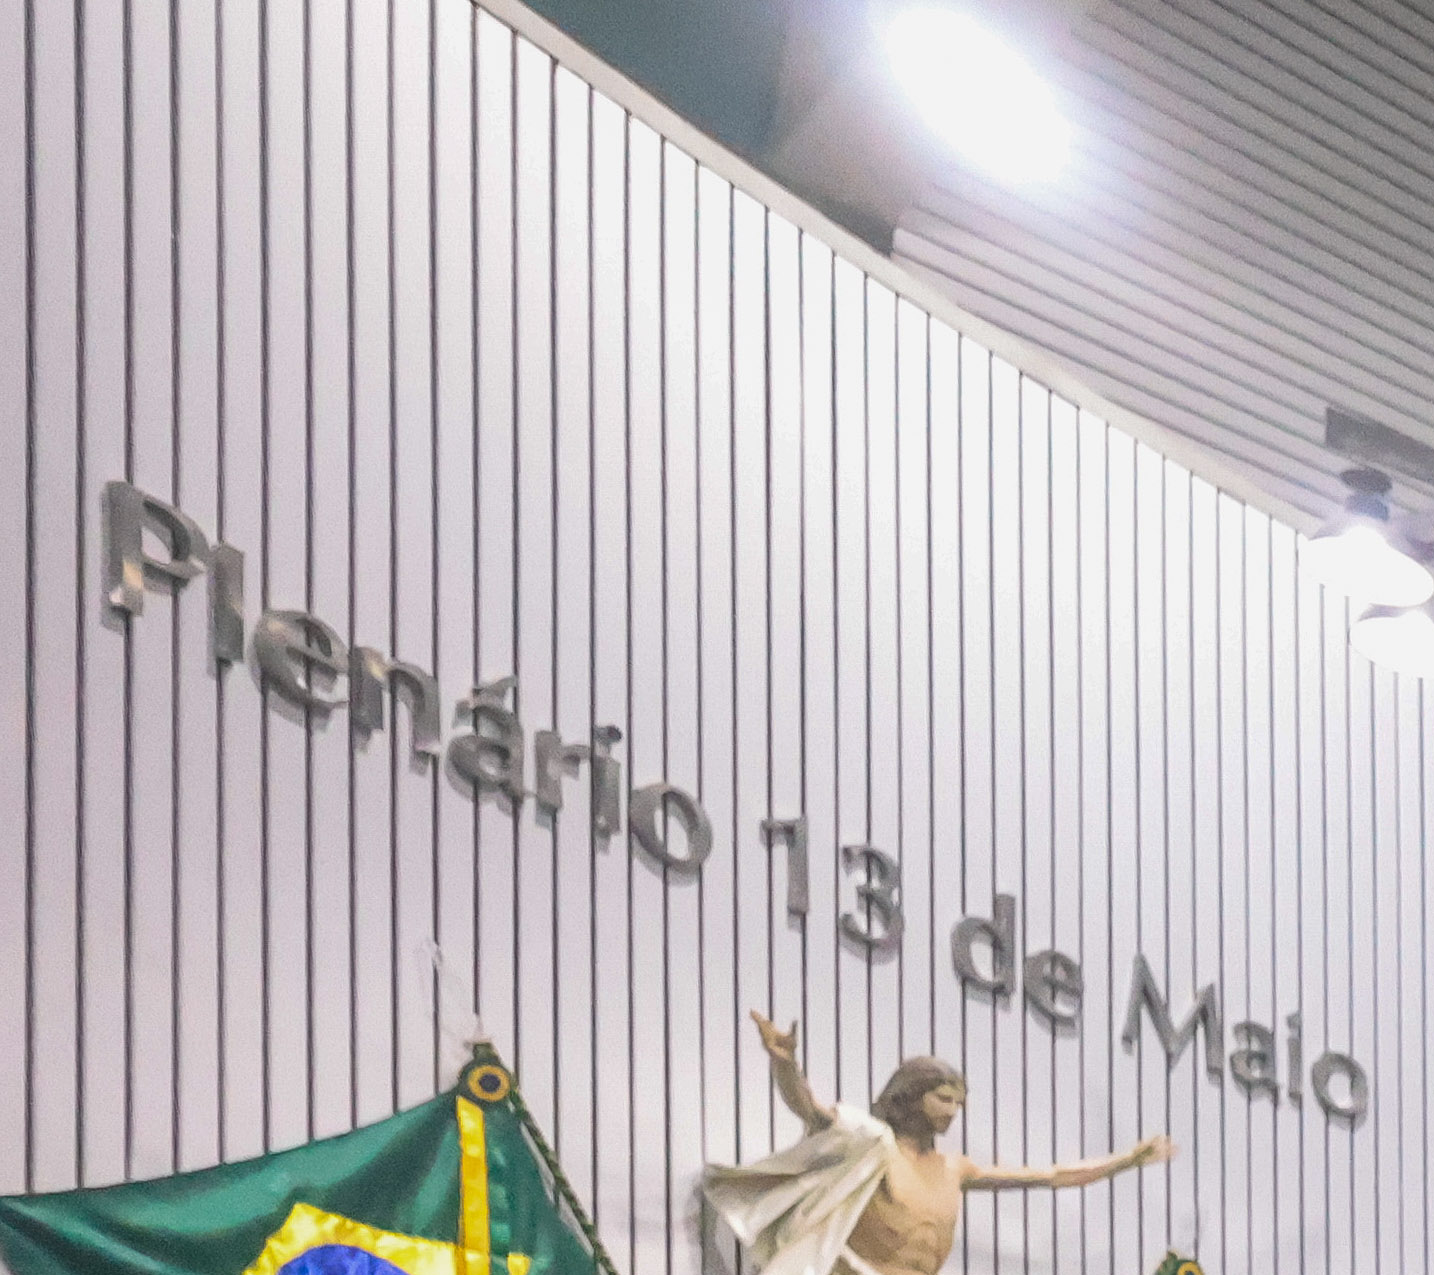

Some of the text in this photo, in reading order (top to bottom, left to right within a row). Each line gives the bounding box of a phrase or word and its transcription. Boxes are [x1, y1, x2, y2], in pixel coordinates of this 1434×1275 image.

[102, 480, 1368, 1120] Plenário 13 de Maio
